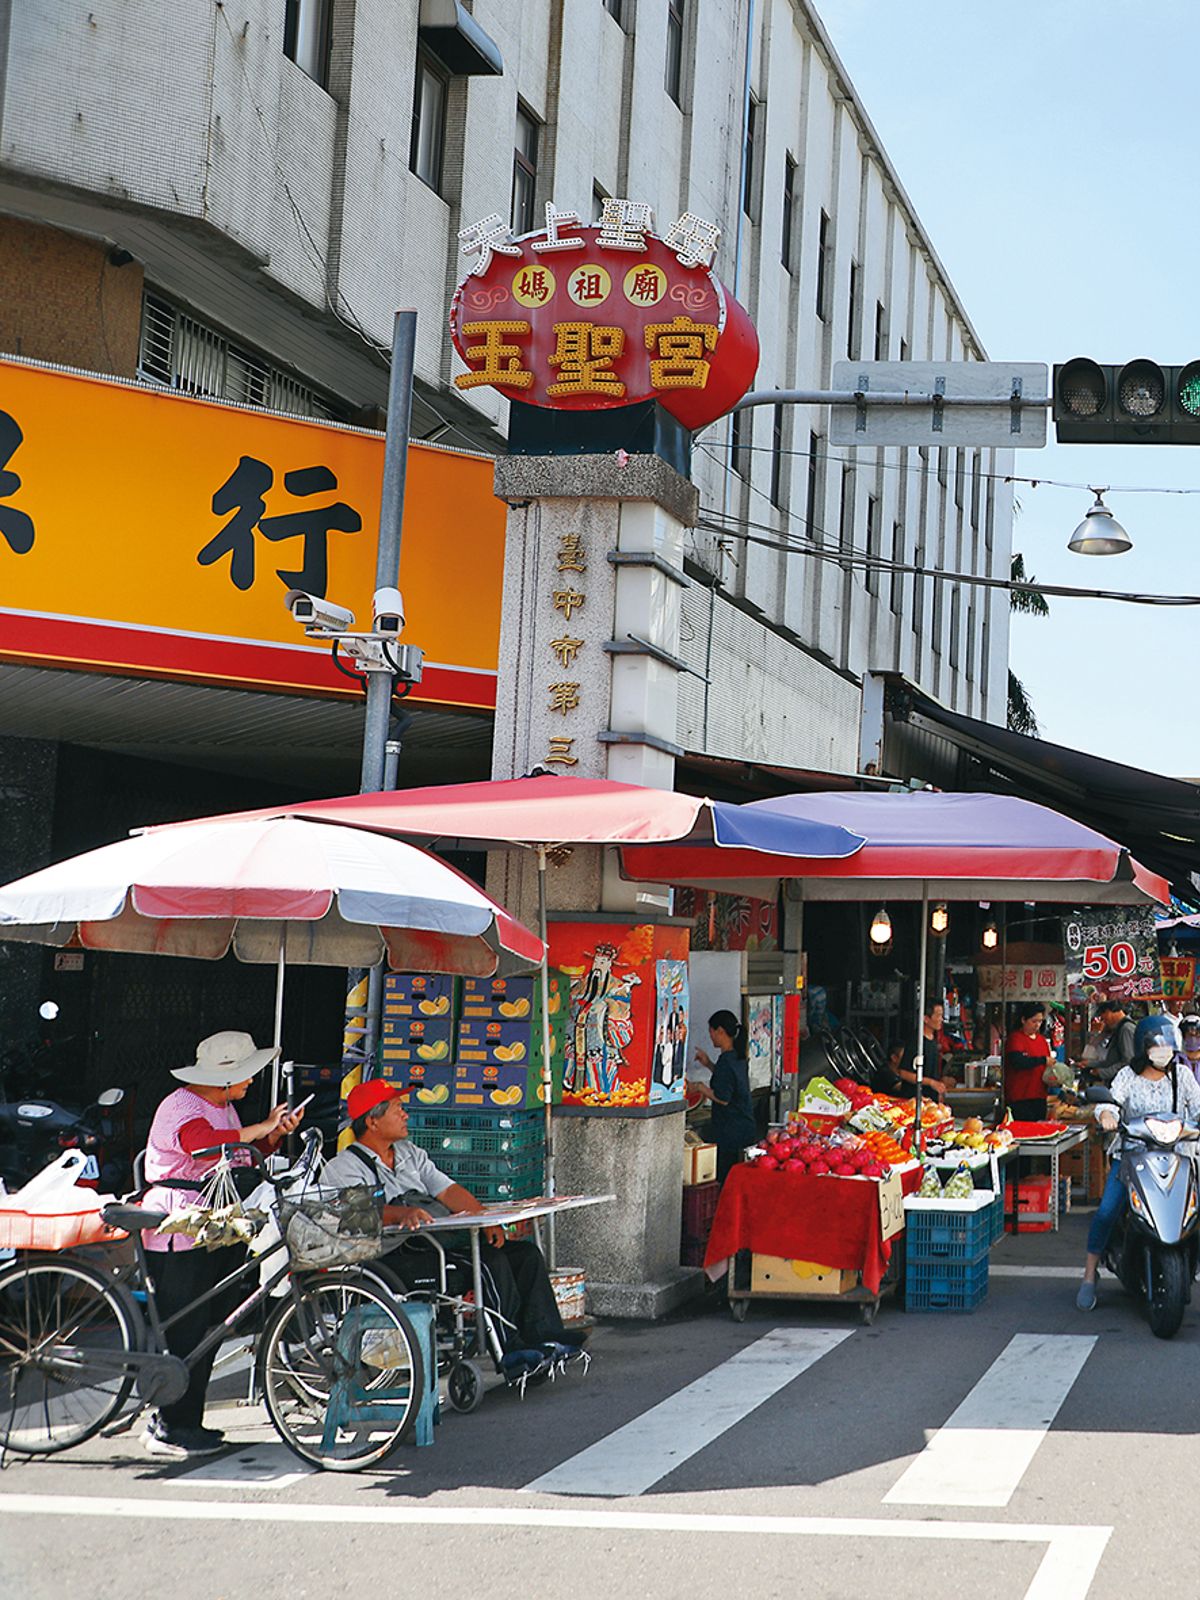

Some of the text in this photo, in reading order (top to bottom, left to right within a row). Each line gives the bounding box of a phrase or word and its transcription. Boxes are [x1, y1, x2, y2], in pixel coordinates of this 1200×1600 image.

[457, 198, 722, 277] 天上聖母
[517, 270, 660, 303] 媽祖廟
[454, 316, 720, 399] 玉聖宮
[544, 533, 586, 868] 臺中市第三
[1163, 980, 1186, 997] 67
